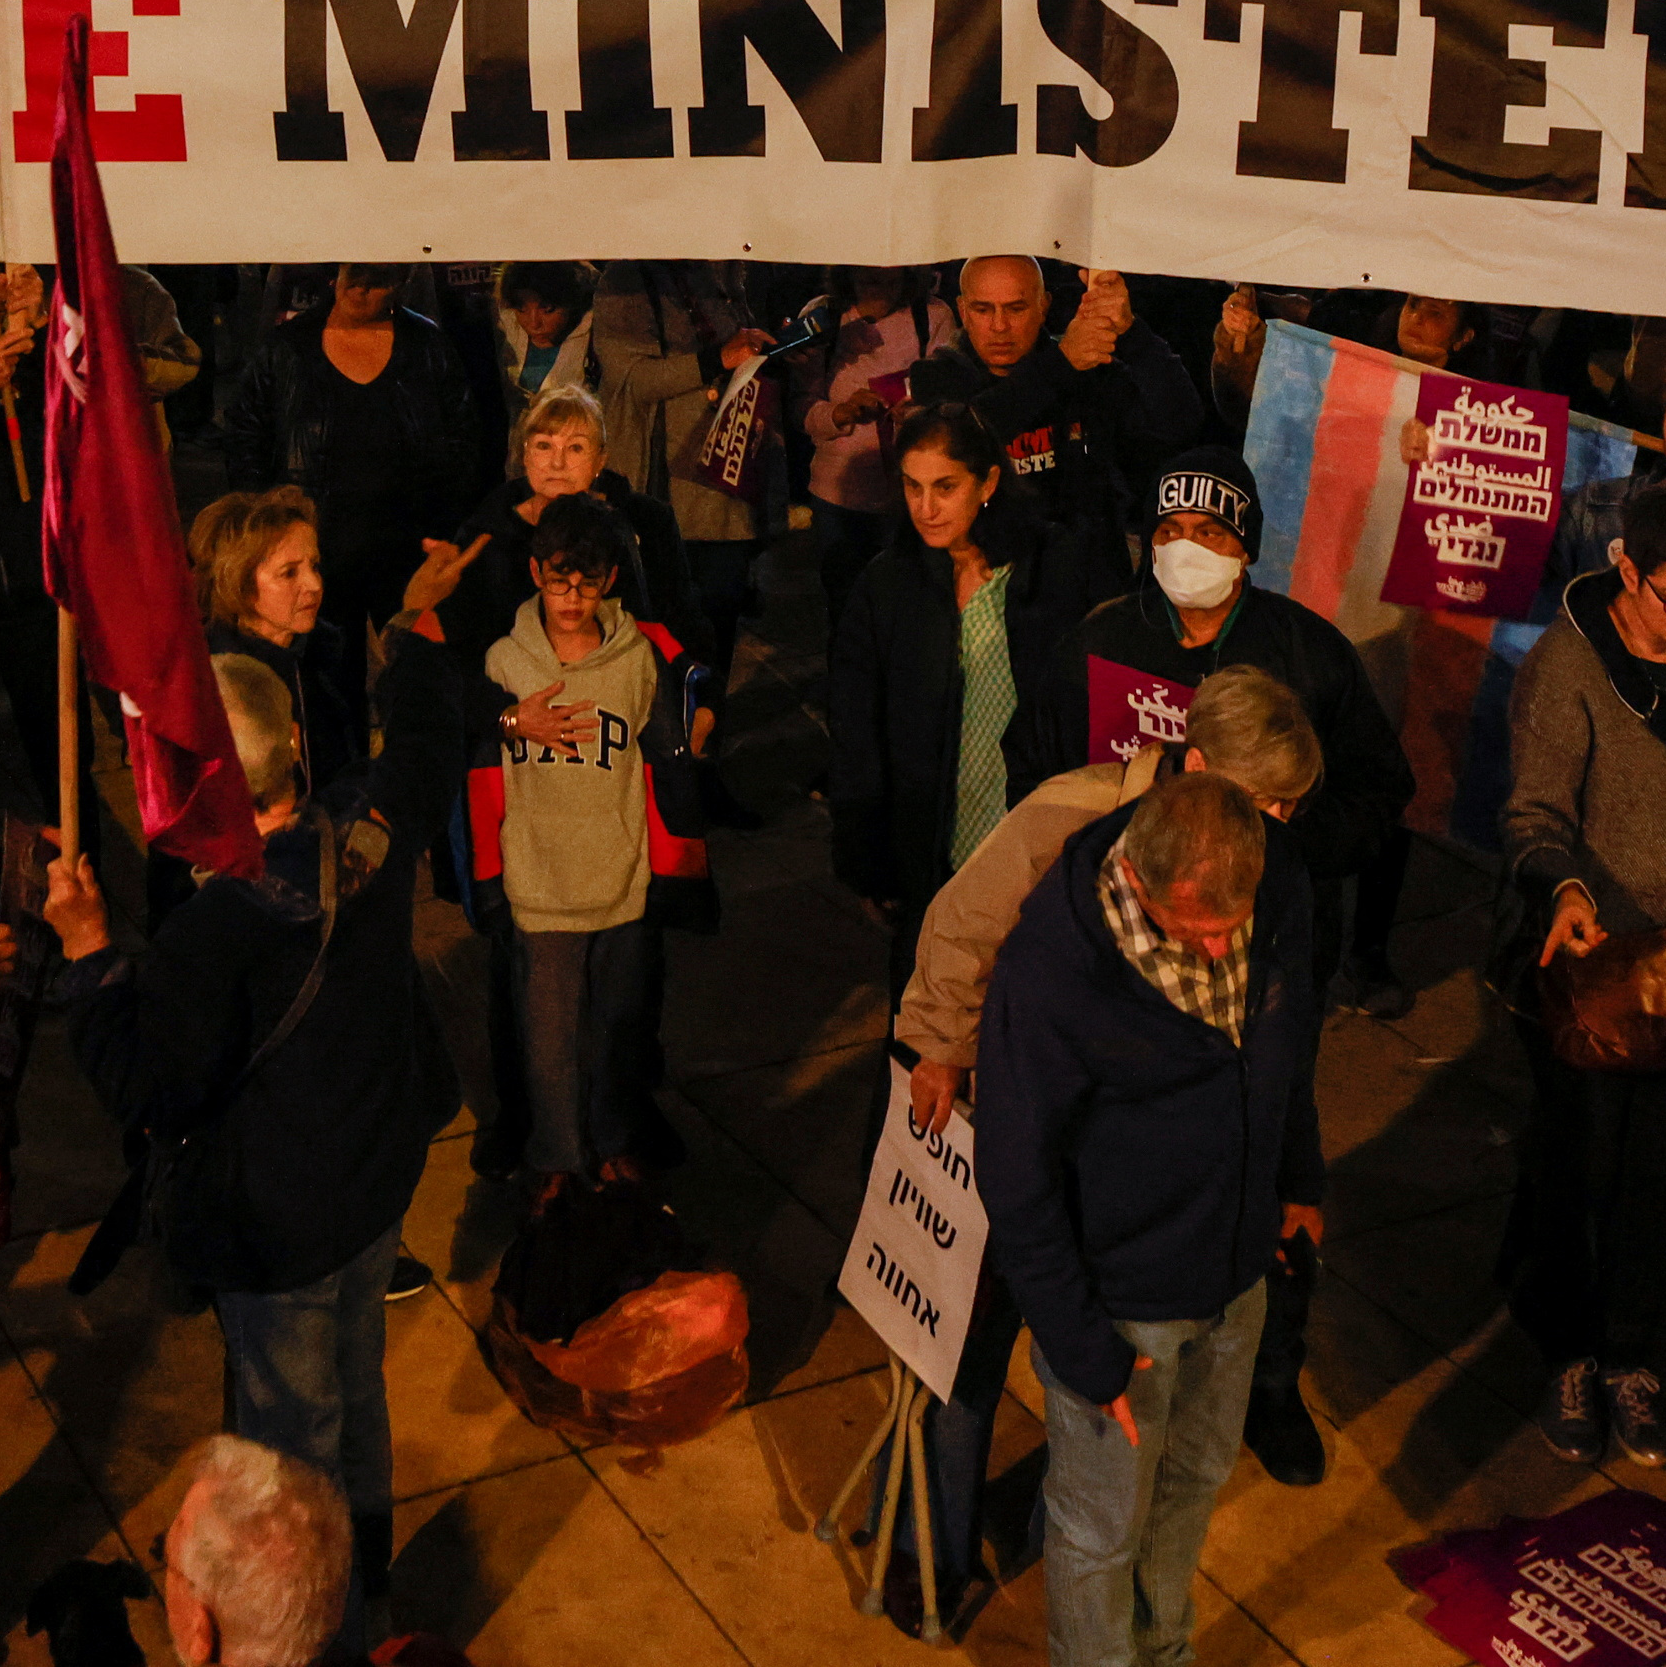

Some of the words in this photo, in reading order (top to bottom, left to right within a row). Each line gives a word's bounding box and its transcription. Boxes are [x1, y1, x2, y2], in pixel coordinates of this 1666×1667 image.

[1454, 385, 1534, 427] حكومة
[1438, 416, 1542, 454] ממשלת
[1160, 476, 1245, 527] GUILTY
[1419, 477, 1548, 518] המתנחלים
[1445, 536, 1499, 563] נגדי
[908, 1103, 971, 1191] חופש
[888, 1168, 957, 1250] שוויון
[866, 1241, 941, 1339] אחווה
[1523, 1609, 1585, 1656] נגדי
